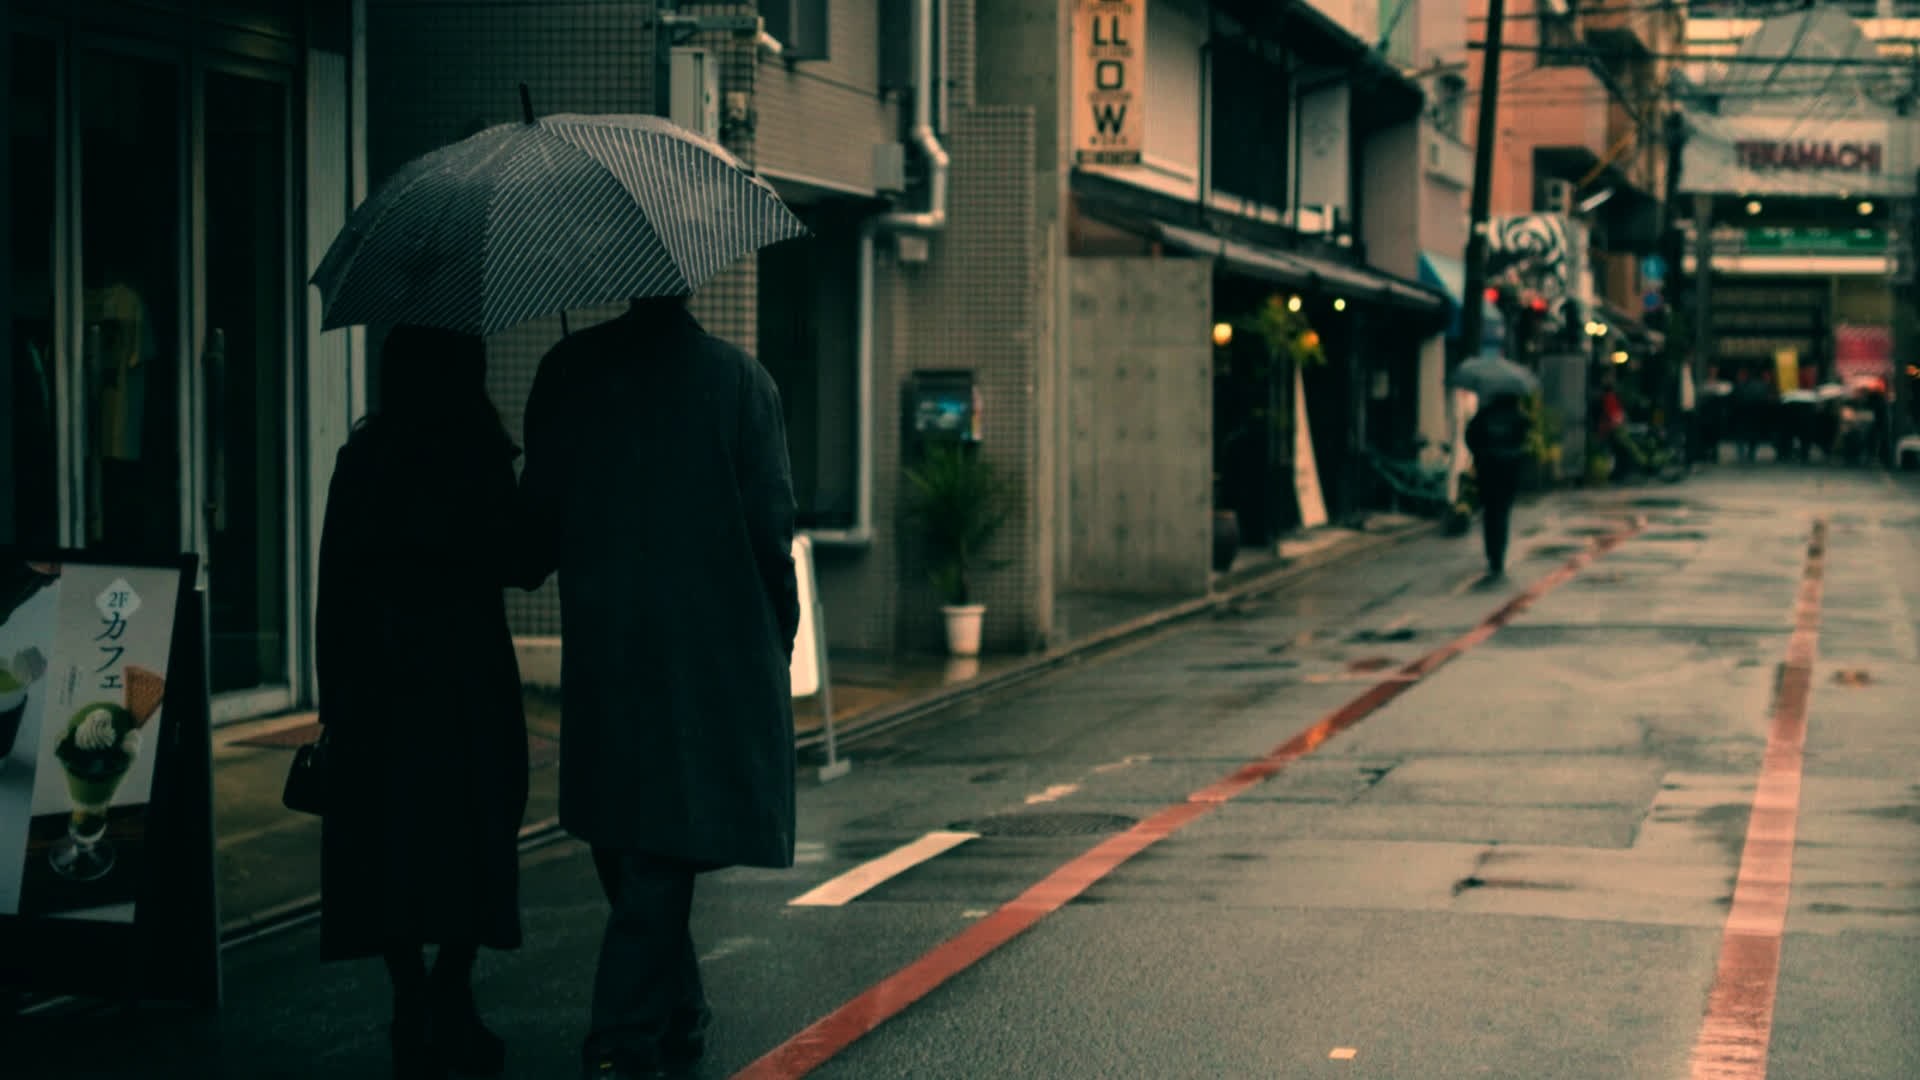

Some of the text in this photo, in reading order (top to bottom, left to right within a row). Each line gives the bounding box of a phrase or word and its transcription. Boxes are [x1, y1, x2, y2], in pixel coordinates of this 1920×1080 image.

[1094, 0, 1128, 134] LLOW
[107, 591, 130, 608] 2F
[93, 610, 127, 689] カフェ
